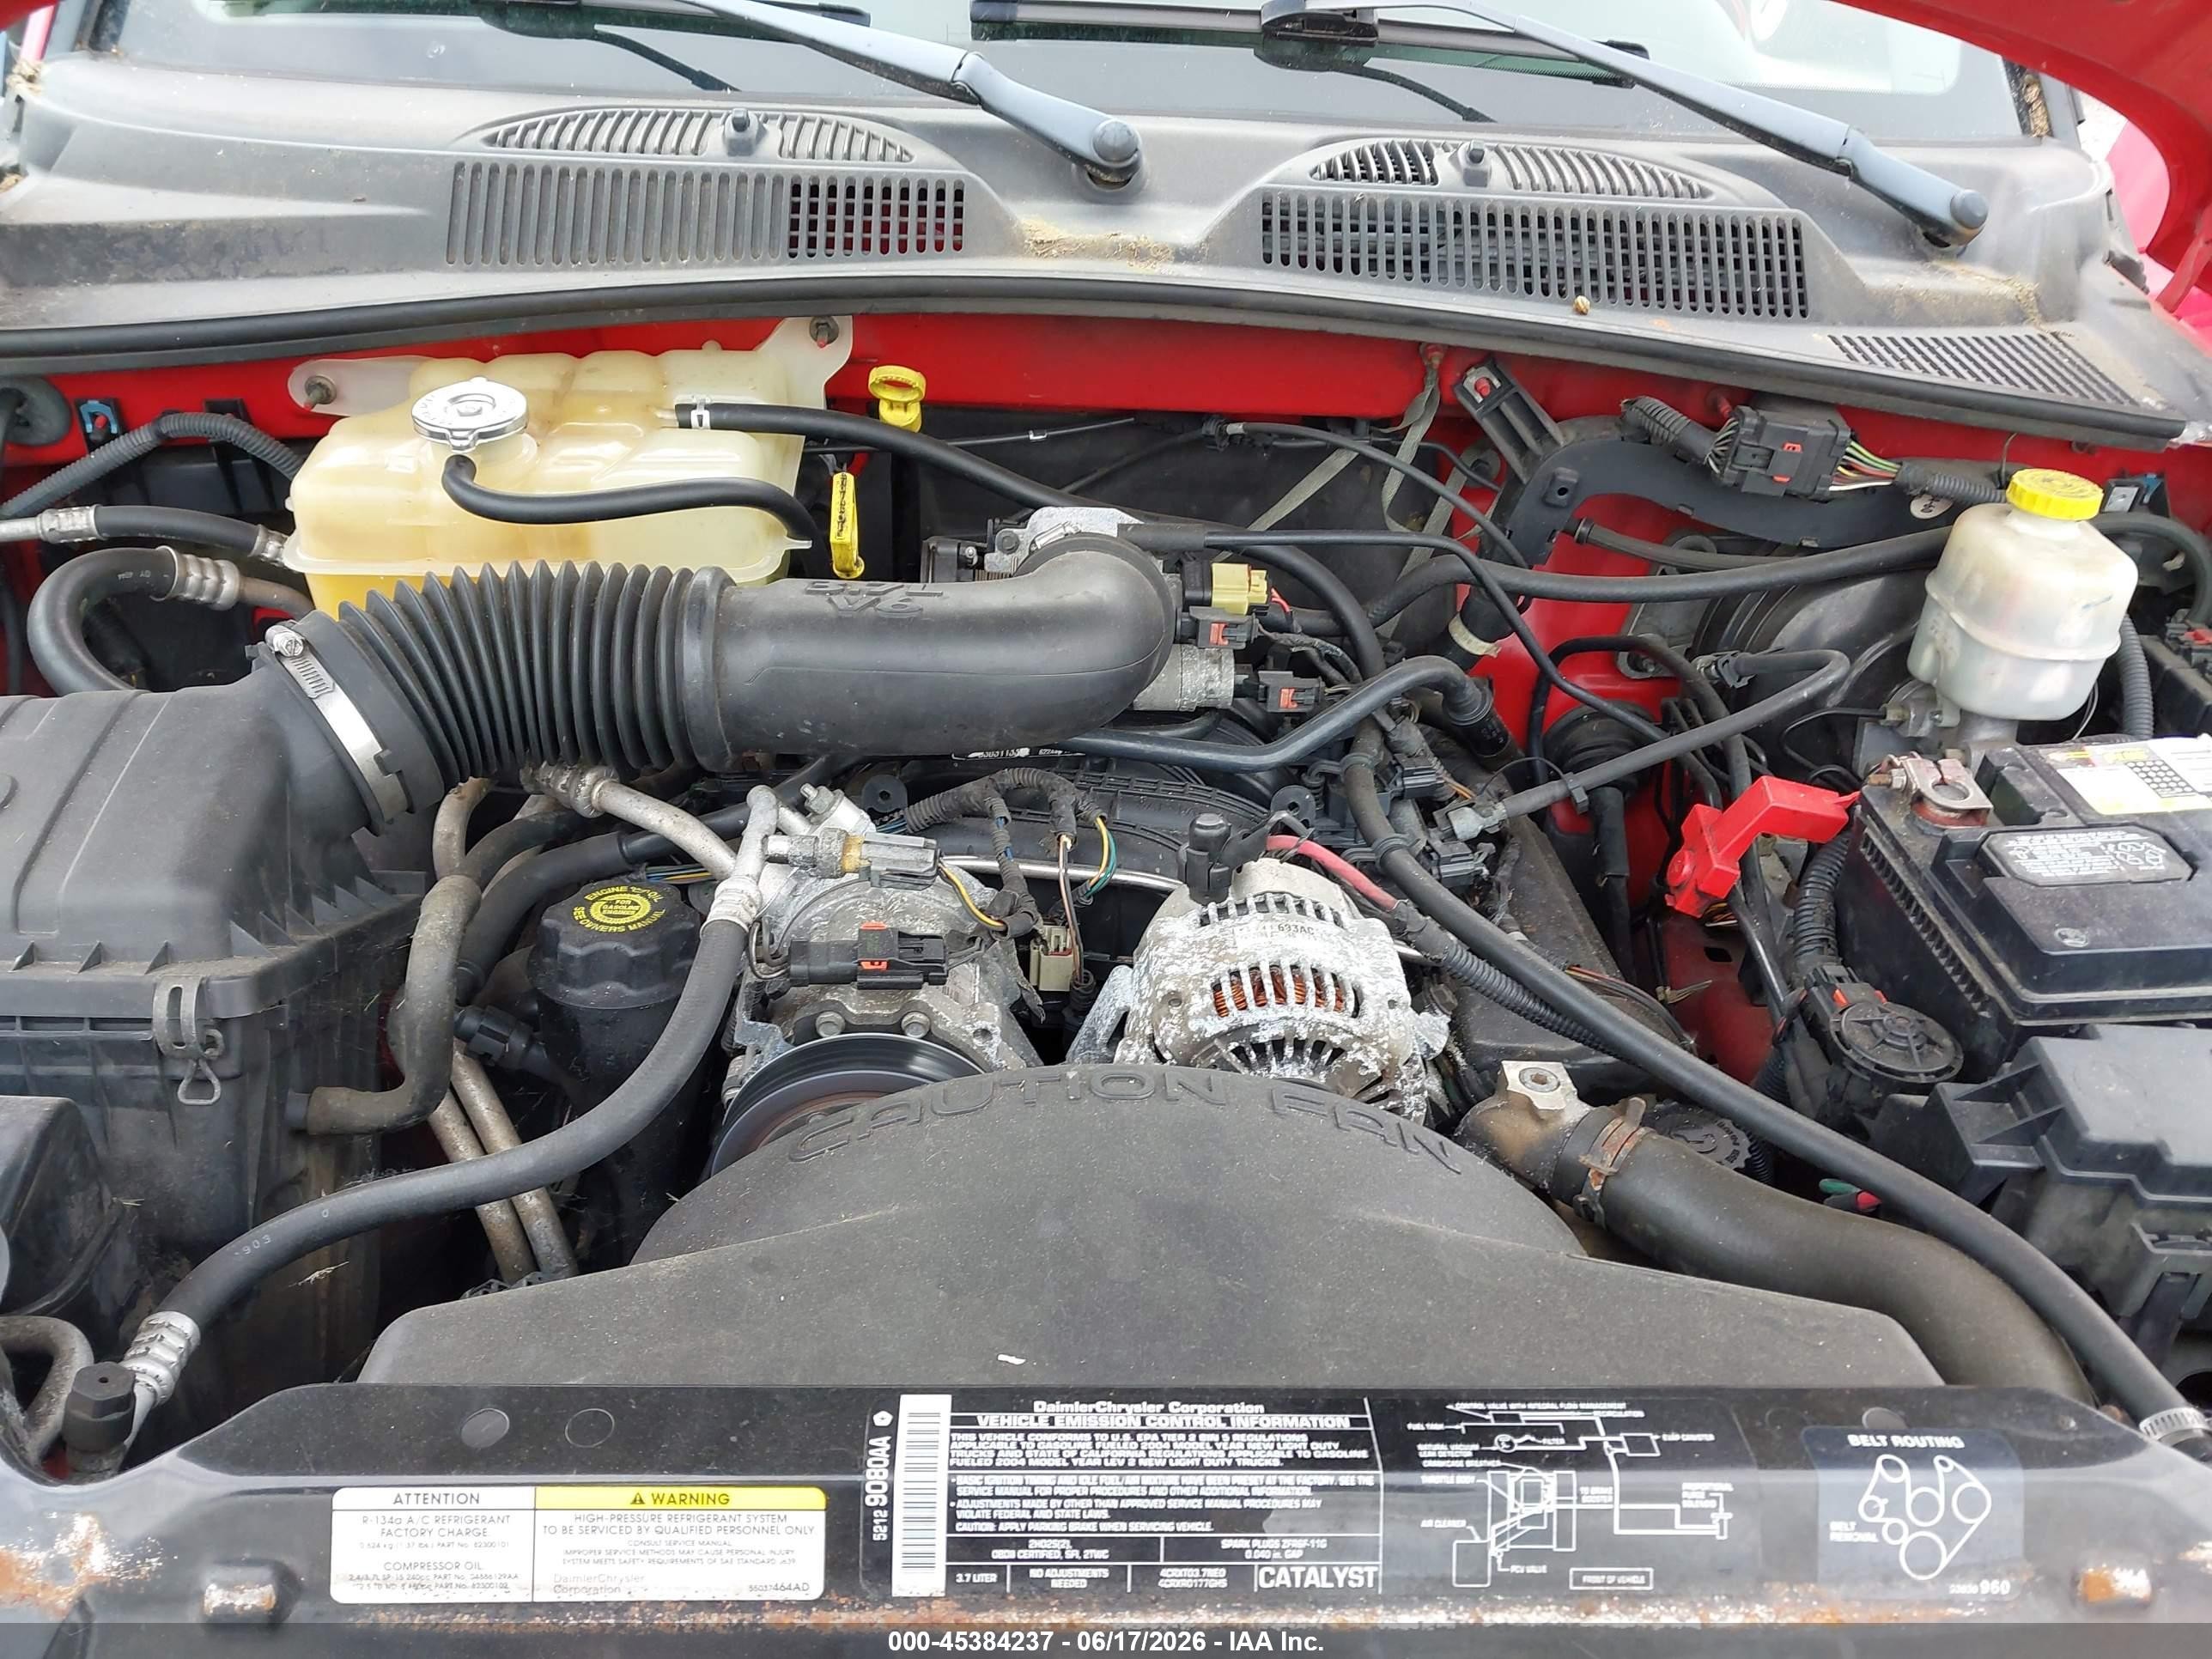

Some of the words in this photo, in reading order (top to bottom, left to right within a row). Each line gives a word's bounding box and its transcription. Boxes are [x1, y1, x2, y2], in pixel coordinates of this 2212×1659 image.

[828, 597, 923, 617] V6
[585, 886, 629, 900] ENGINE
[648, 891, 664, 902] OIL
[573, 906, 585, 921] SEE
[580, 919, 625, 933] OWNERS
[628, 908, 666, 931] MANUAL
[787, 1071, 1228, 1164] CAUTION
[1034, 1401, 1164, 1414] DaimlerChrysler
[1168, 1401, 1265, 1415] Corporation
[977, 1416, 1049, 1427] VEHICLE
[1054, 1416, 1142, 1427] EMISSION
[1146, 1416, 1227, 1427] CONTROL
[1231, 1416, 1350, 1428] INFORMATION
[951, 1433, 976, 1442] THIS
[979, 1433, 1024, 1442] VEHICLE
[1027, 1433, 1091, 1442] CONFORMS
[1093, 1433, 1109, 1442] TO
[1137, 1433, 1158, 1442] EPA
[1847, 1435, 1887, 1448] BELT
[1891, 1435, 1965, 1448] ROUTING
[1169, 1458, 1201, 1467] LIGHT
[1203, 1458, 1232, 1467] DUTY
[1236, 1458, 1284, 1467] TRUCKS.
[865, 1436, 891, 1507] 9080AA
[957, 1486, 994, 1496] SERVICE
[1034, 1486, 1052, 1496] FOR
[1054, 1486, 1089, 1496] PROPER
[1090, 1486, 1147, 1496] PROCEDURES
[1170, 1486, 1199, 1496] OTHER
[393, 1493, 480, 1504] ATTENTION
[652, 1493, 730, 1504] WARNING
[957, 1499, 1020, 1508] ADJUSTMENTS
[1022, 1499, 1048, 1508] MADE
[1049, 1499, 1062, 1508] BY
[1064, 1499, 1093, 1508] OTHER
[1120, 1499, 1165, 1508] APPROVED
[1167, 1499, 1203, 1508] SERVICE
[574, 1514, 663, 1523] HIGH-PRESSURE
[667, 1514, 742, 1523] REFRIGERANT
[746, 1514, 787, 1523] SYSTEM
[956, 1510, 992, 1519] VIOLATE
[993, 1510, 1031, 1519] FEDERAL
[1033, 1510, 1053, 1519] AND
[1054, 1510, 1081, 1519] STATE
[362, 1516, 402, 1525] R-134a
[407, 1516, 429, 1525] A/C
[434, 1516, 511, 1525] REFRIGERANT
[872, 1510, 888, 1540] 5212
[544, 1526, 557, 1534] TO
[562, 1526, 574, 1534] BE
[578, 1526, 632, 1534] SERVICED
[637, 1526, 650, 1534] BY
[654, 1526, 712, 1534] QUALIFIED
[717, 1526, 781, 1534] PERSONNEL
[998, 1522, 1026, 1531] APPLY
[1068, 1522, 1097, 1531] BRAKE
[1099, 1522, 1127, 1531] WHEN
[1830, 1522, 1856, 1531] BELT
[380, 1528, 434, 1537] FACTORY
[1221, 1540, 1250, 1549] SPARK
[1252, 1540, 1279, 1549] PLUGS
[384, 1562, 460, 1571] COMPRESSOR
[956, 1573, 971, 1583] 3.7
[973, 1573, 997, 1583] LITER
[1030, 1569, 1044, 1577] NO
[1258, 1566, 1378, 1589] CATALYST
[554, 1574, 644, 1584] DaimlerChrysler
[553, 1585, 621, 1595] Corporation
